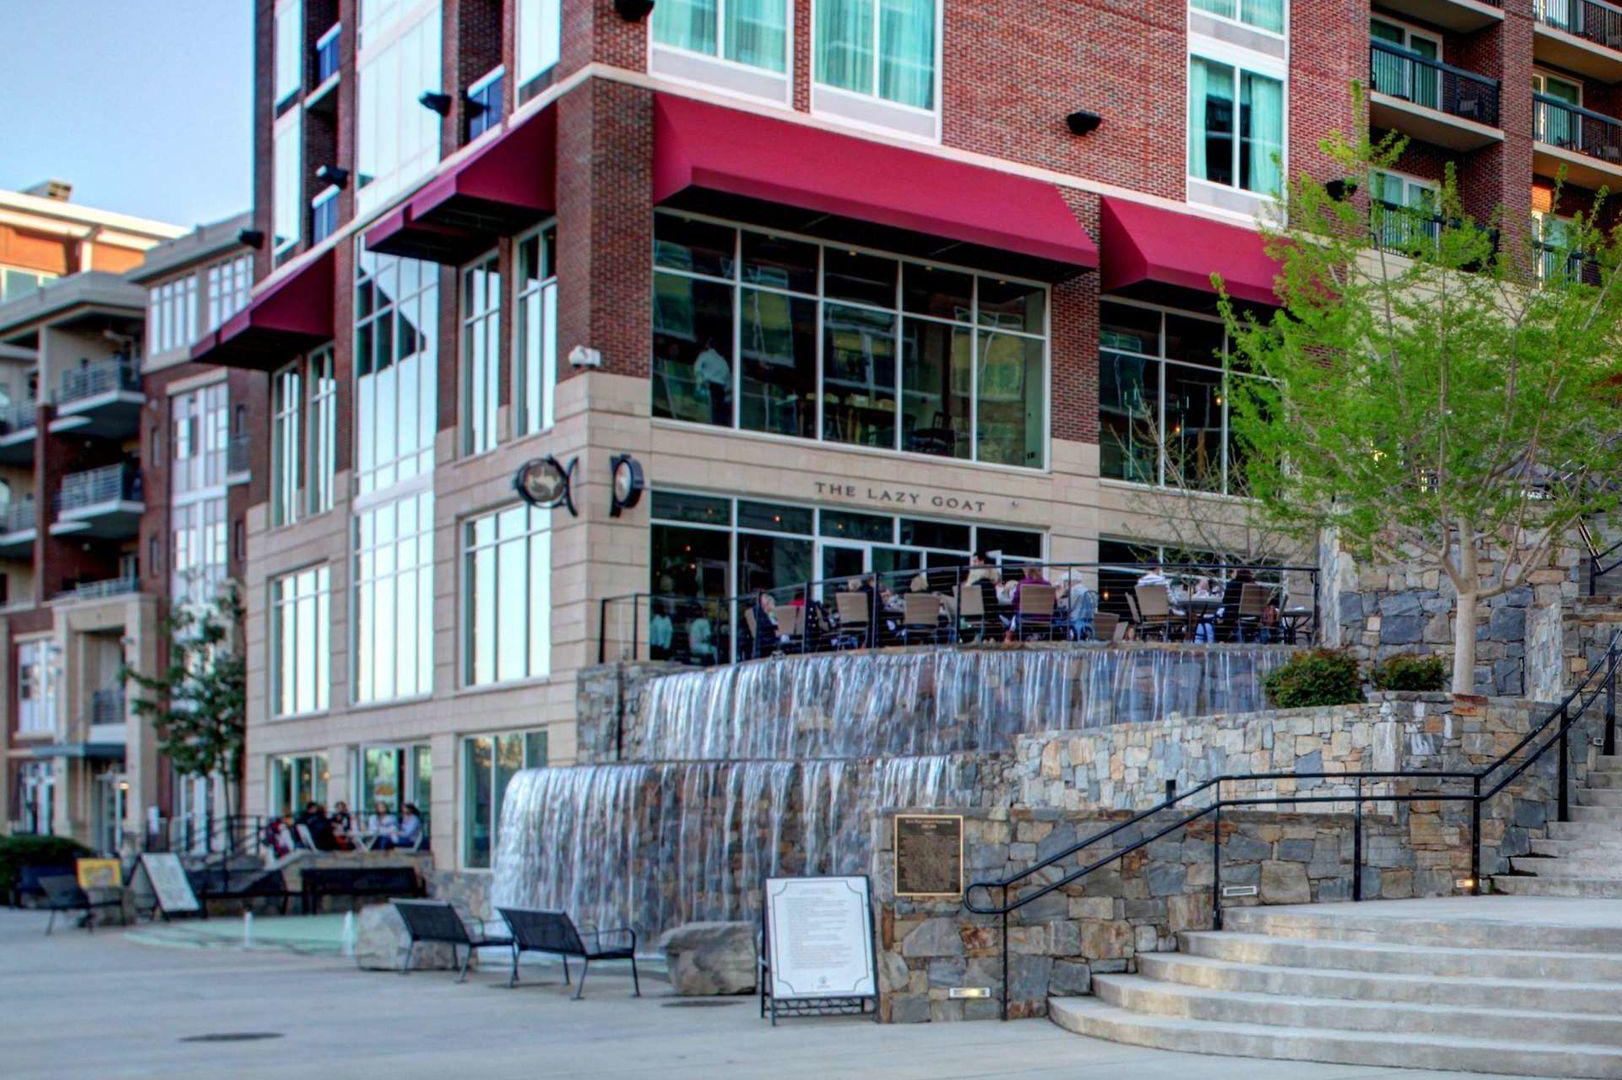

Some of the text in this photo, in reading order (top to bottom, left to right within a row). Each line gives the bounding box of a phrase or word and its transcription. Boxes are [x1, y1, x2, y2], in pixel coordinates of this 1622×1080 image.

[815, 482, 987, 512] THE LAZY GOAT
